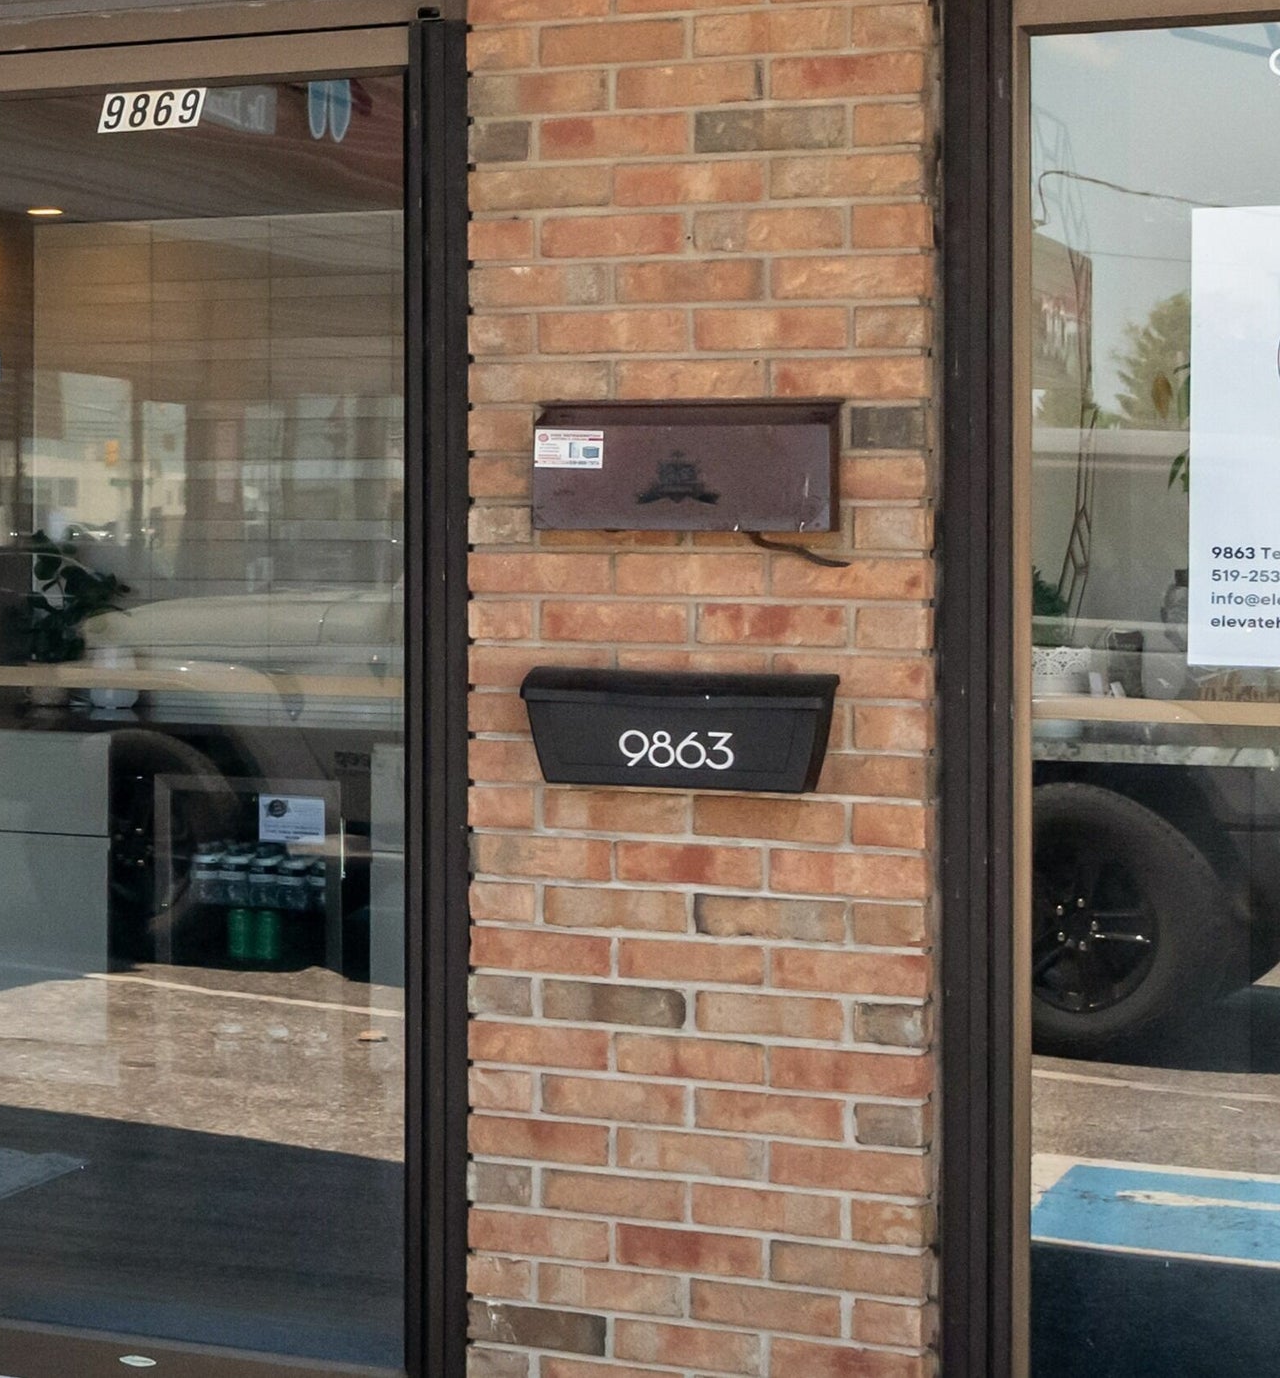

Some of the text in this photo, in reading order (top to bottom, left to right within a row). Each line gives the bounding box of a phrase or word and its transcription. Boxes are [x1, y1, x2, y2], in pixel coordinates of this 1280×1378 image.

[103, 89, 201, 130] 9869
[1211, 546, 1255, 560] 9863
[618, 729, 735, 770] 9863
